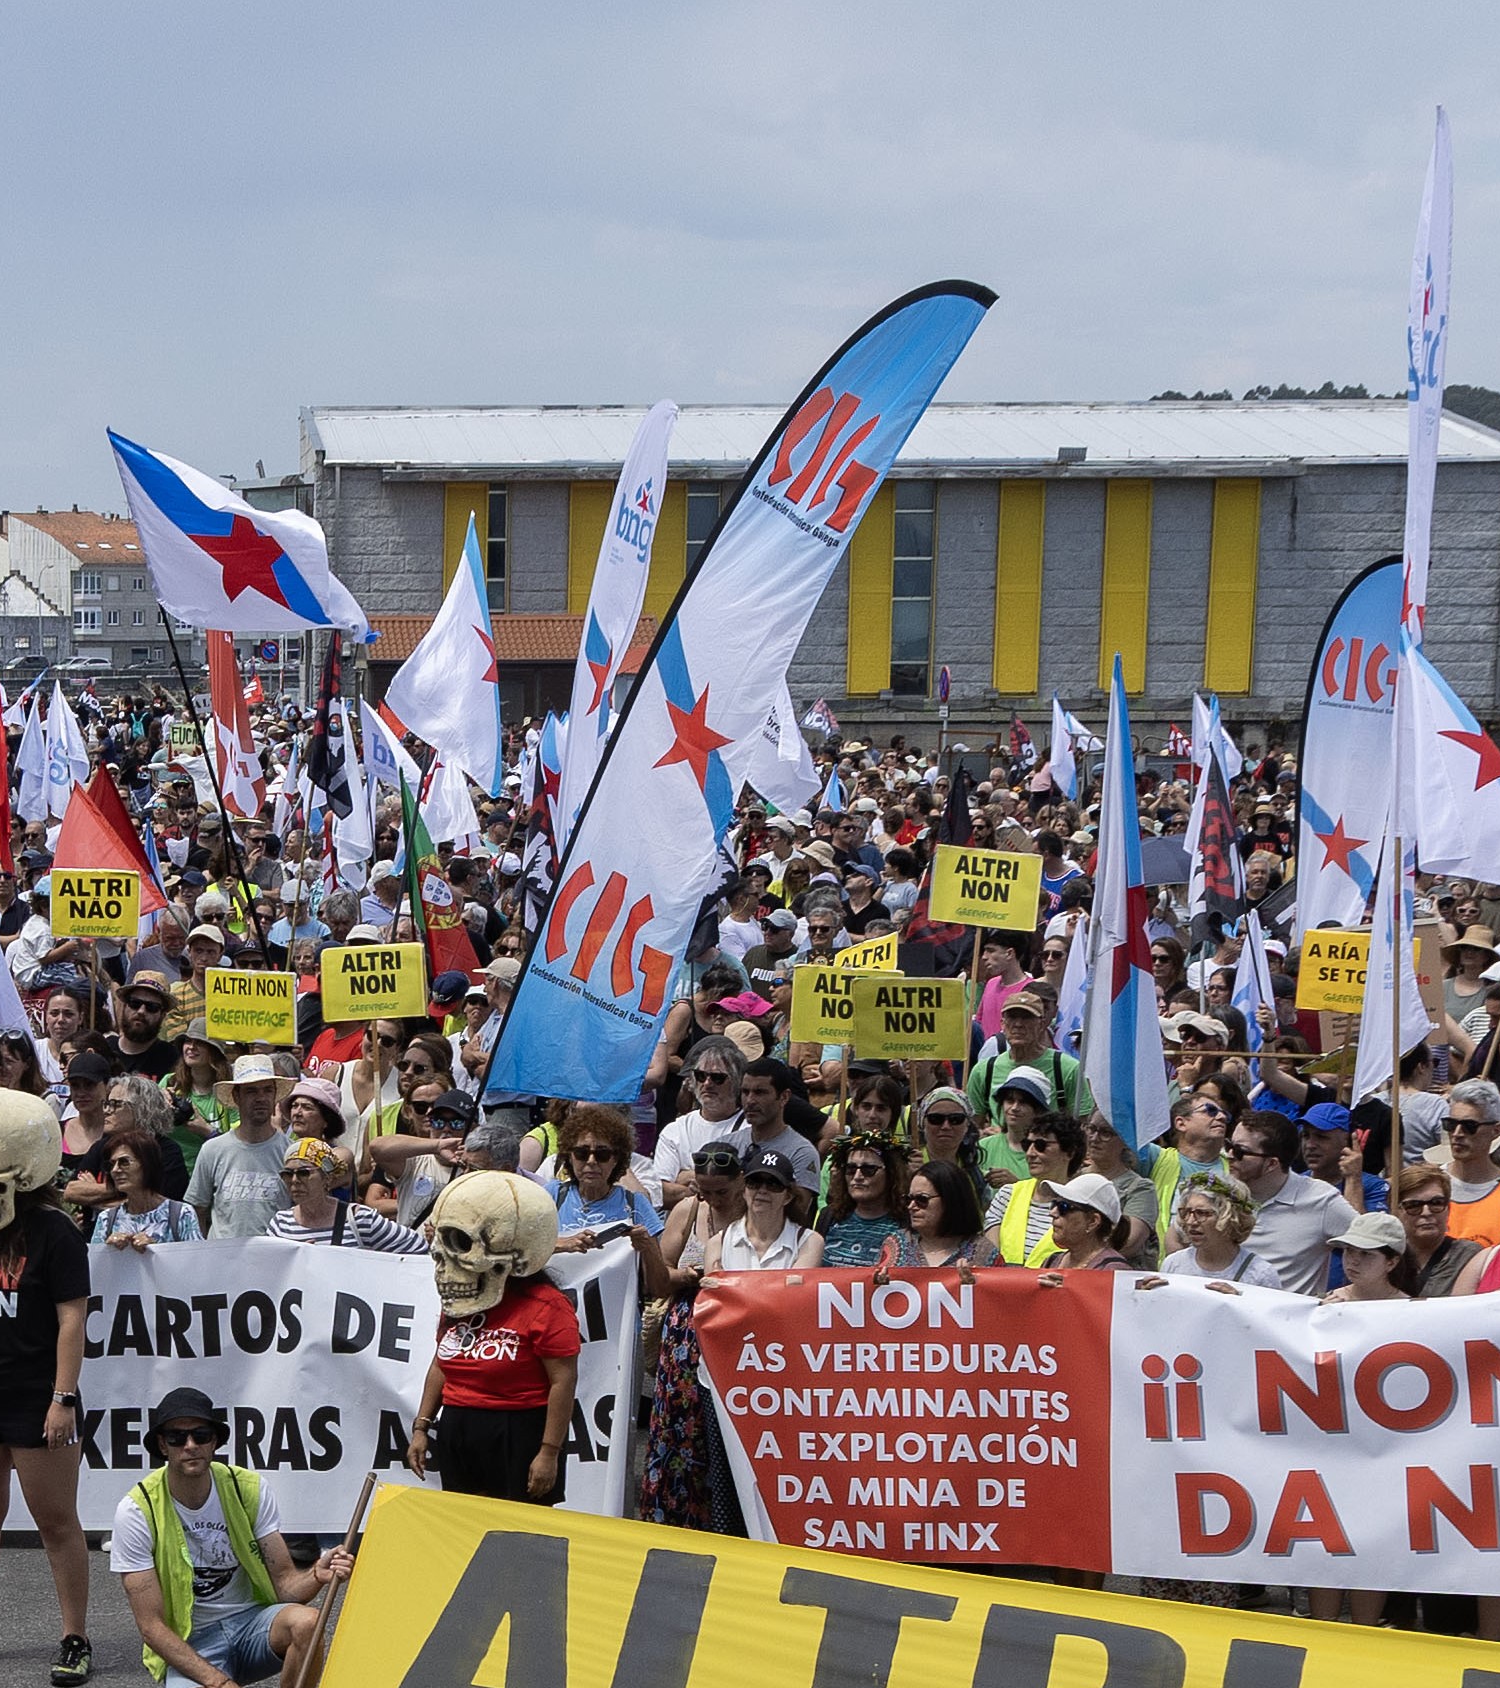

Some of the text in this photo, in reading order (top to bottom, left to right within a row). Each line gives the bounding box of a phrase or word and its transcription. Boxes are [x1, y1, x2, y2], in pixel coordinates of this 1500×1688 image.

[767, 387, 880, 533] CIG
[615, 492, 654, 563] bng
[953, 855, 1020, 881] ALTRI
[58, 878, 131, 897] ALTRI
[960, 878, 1010, 903] NON
[69, 897, 123, 919] NÃO
[545, 860, 674, 1017] CIG
[1308, 940, 1361, 960] A RÍA
[341, 950, 402, 973] ALTRI
[213, 976, 288, 998] ALTRI NON
[350, 974, 397, 996] NON
[1318, 967, 1340, 983] SE
[875, 986, 942, 1009] ALTRI
[209, 1007, 291, 1028] GREENPEACE
[885, 1011, 935, 1034] NON
[817, 1279, 975, 1331] NON
[84, 1289, 302, 1359] CARTOS
[343, 1300, 413, 1363] DE
[737, 1331, 1058, 1377] ÁS VERTEDURAS
[725, 1384, 1070, 1423] CONTAMINANTES
[754, 1425, 1078, 1469] A EXPLOTACIÓN
[776, 1474, 1027, 1509] DA MINA DE
[1173, 1470, 1355, 1558] DA
[803, 1517, 1001, 1553] SAN FINX
